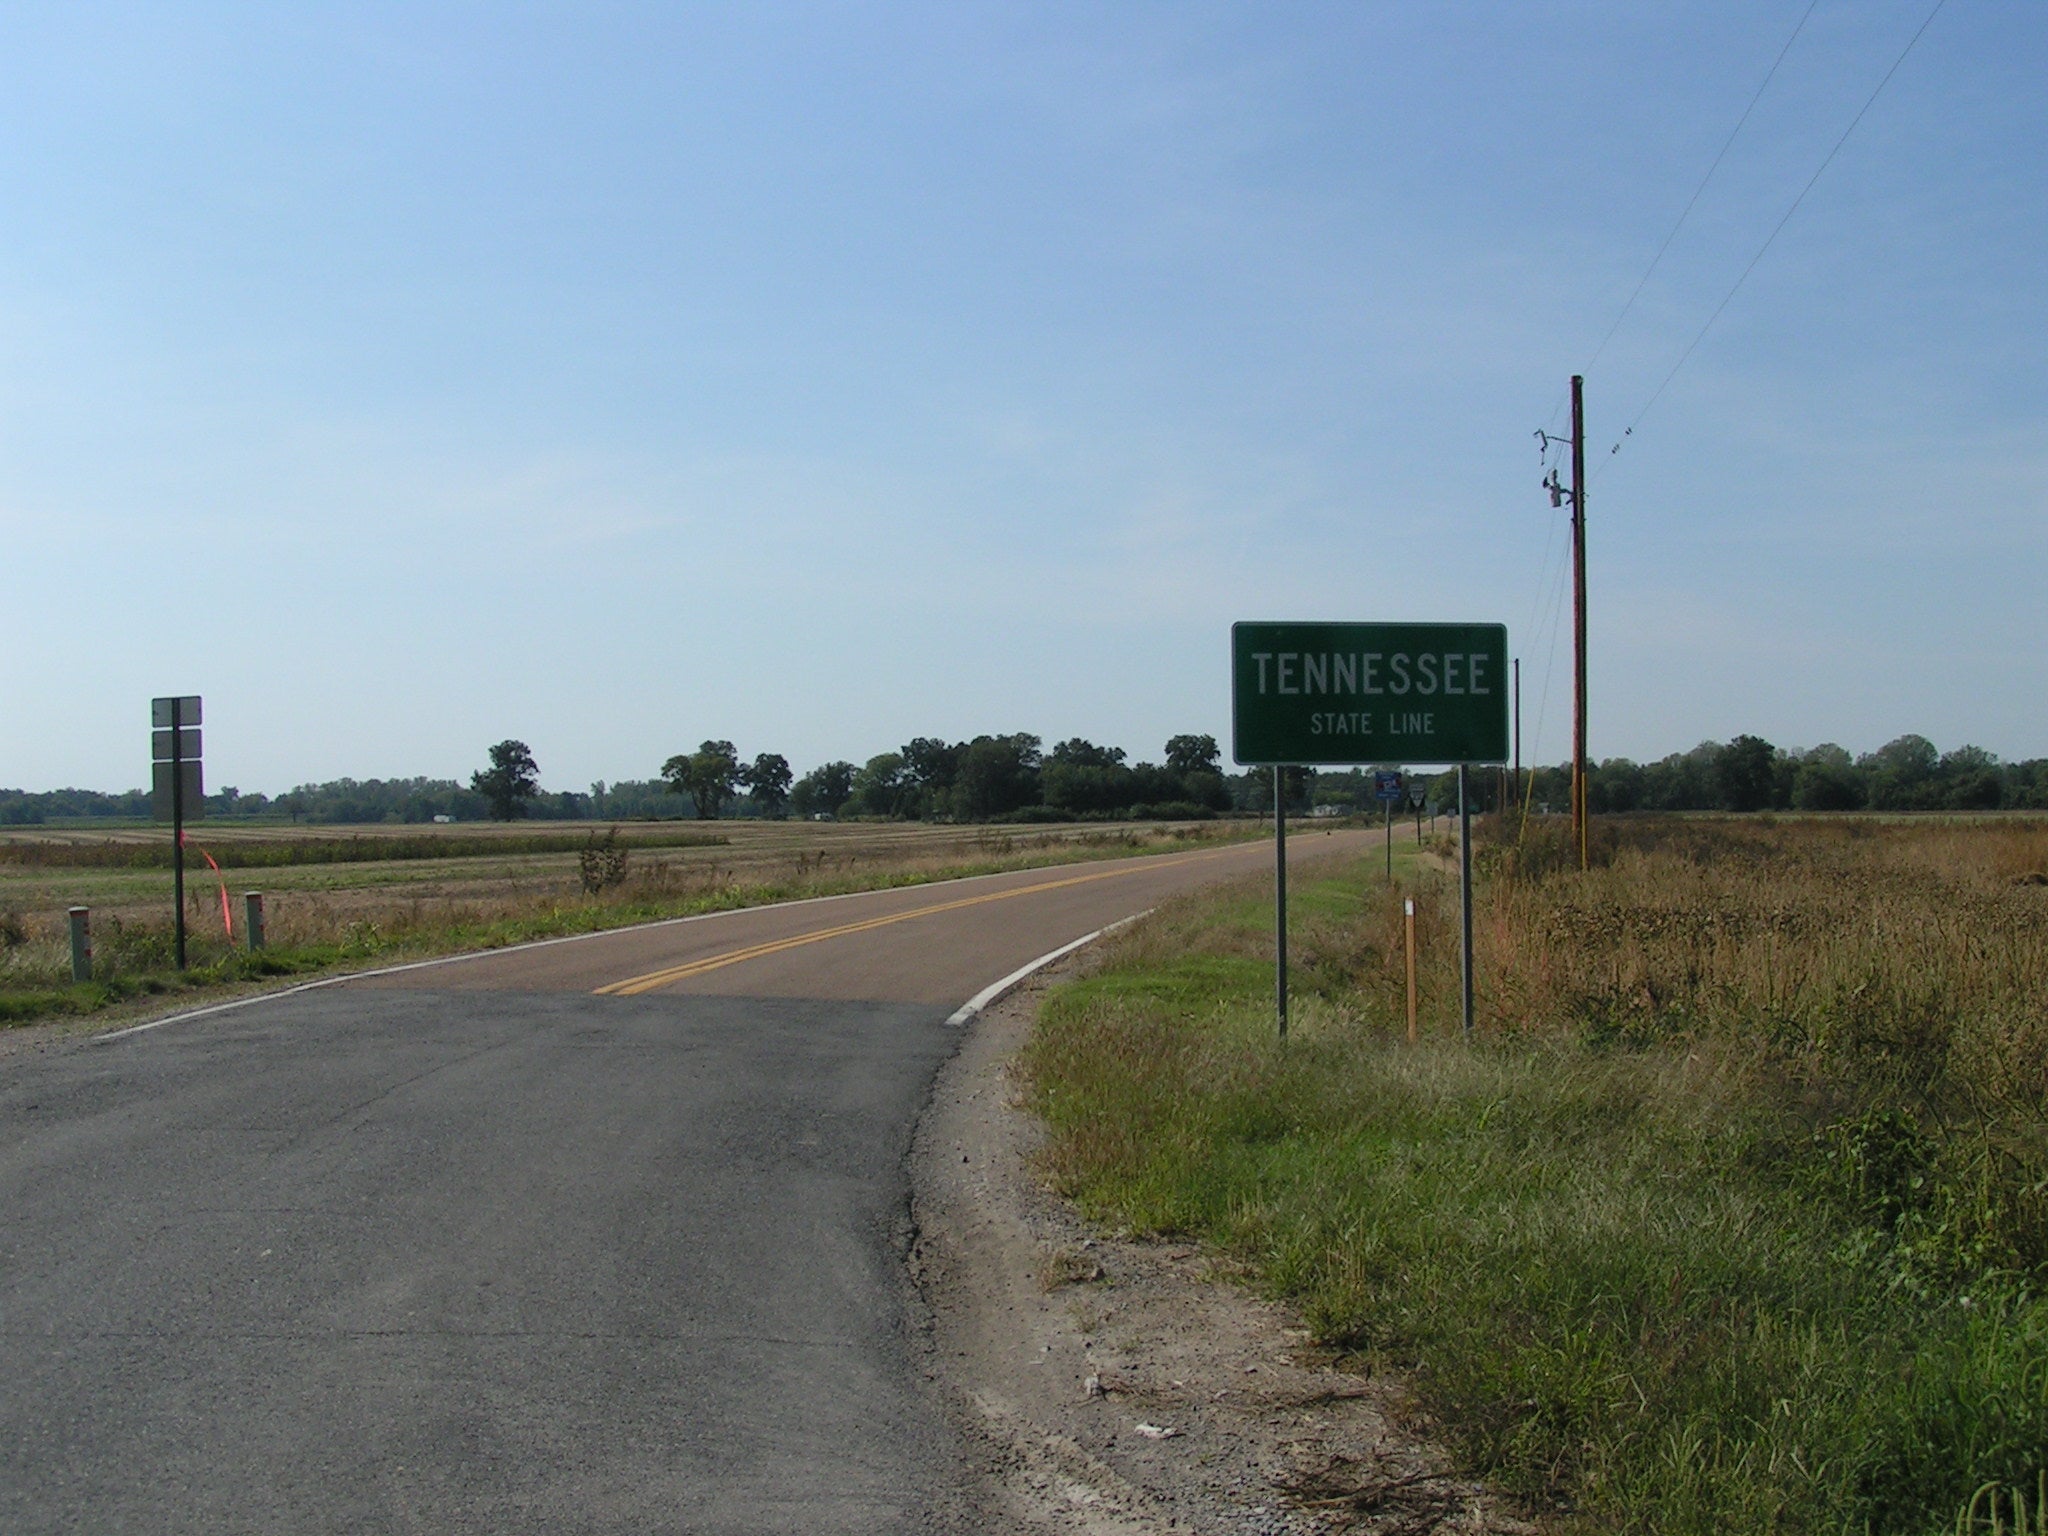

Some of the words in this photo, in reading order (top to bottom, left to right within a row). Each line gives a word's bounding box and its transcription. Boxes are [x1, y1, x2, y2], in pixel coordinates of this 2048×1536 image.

[1251, 652, 1490, 695] TENNESSEE
[1311, 713, 1373, 735] STATE
[1389, 713, 1435, 735] LINE
